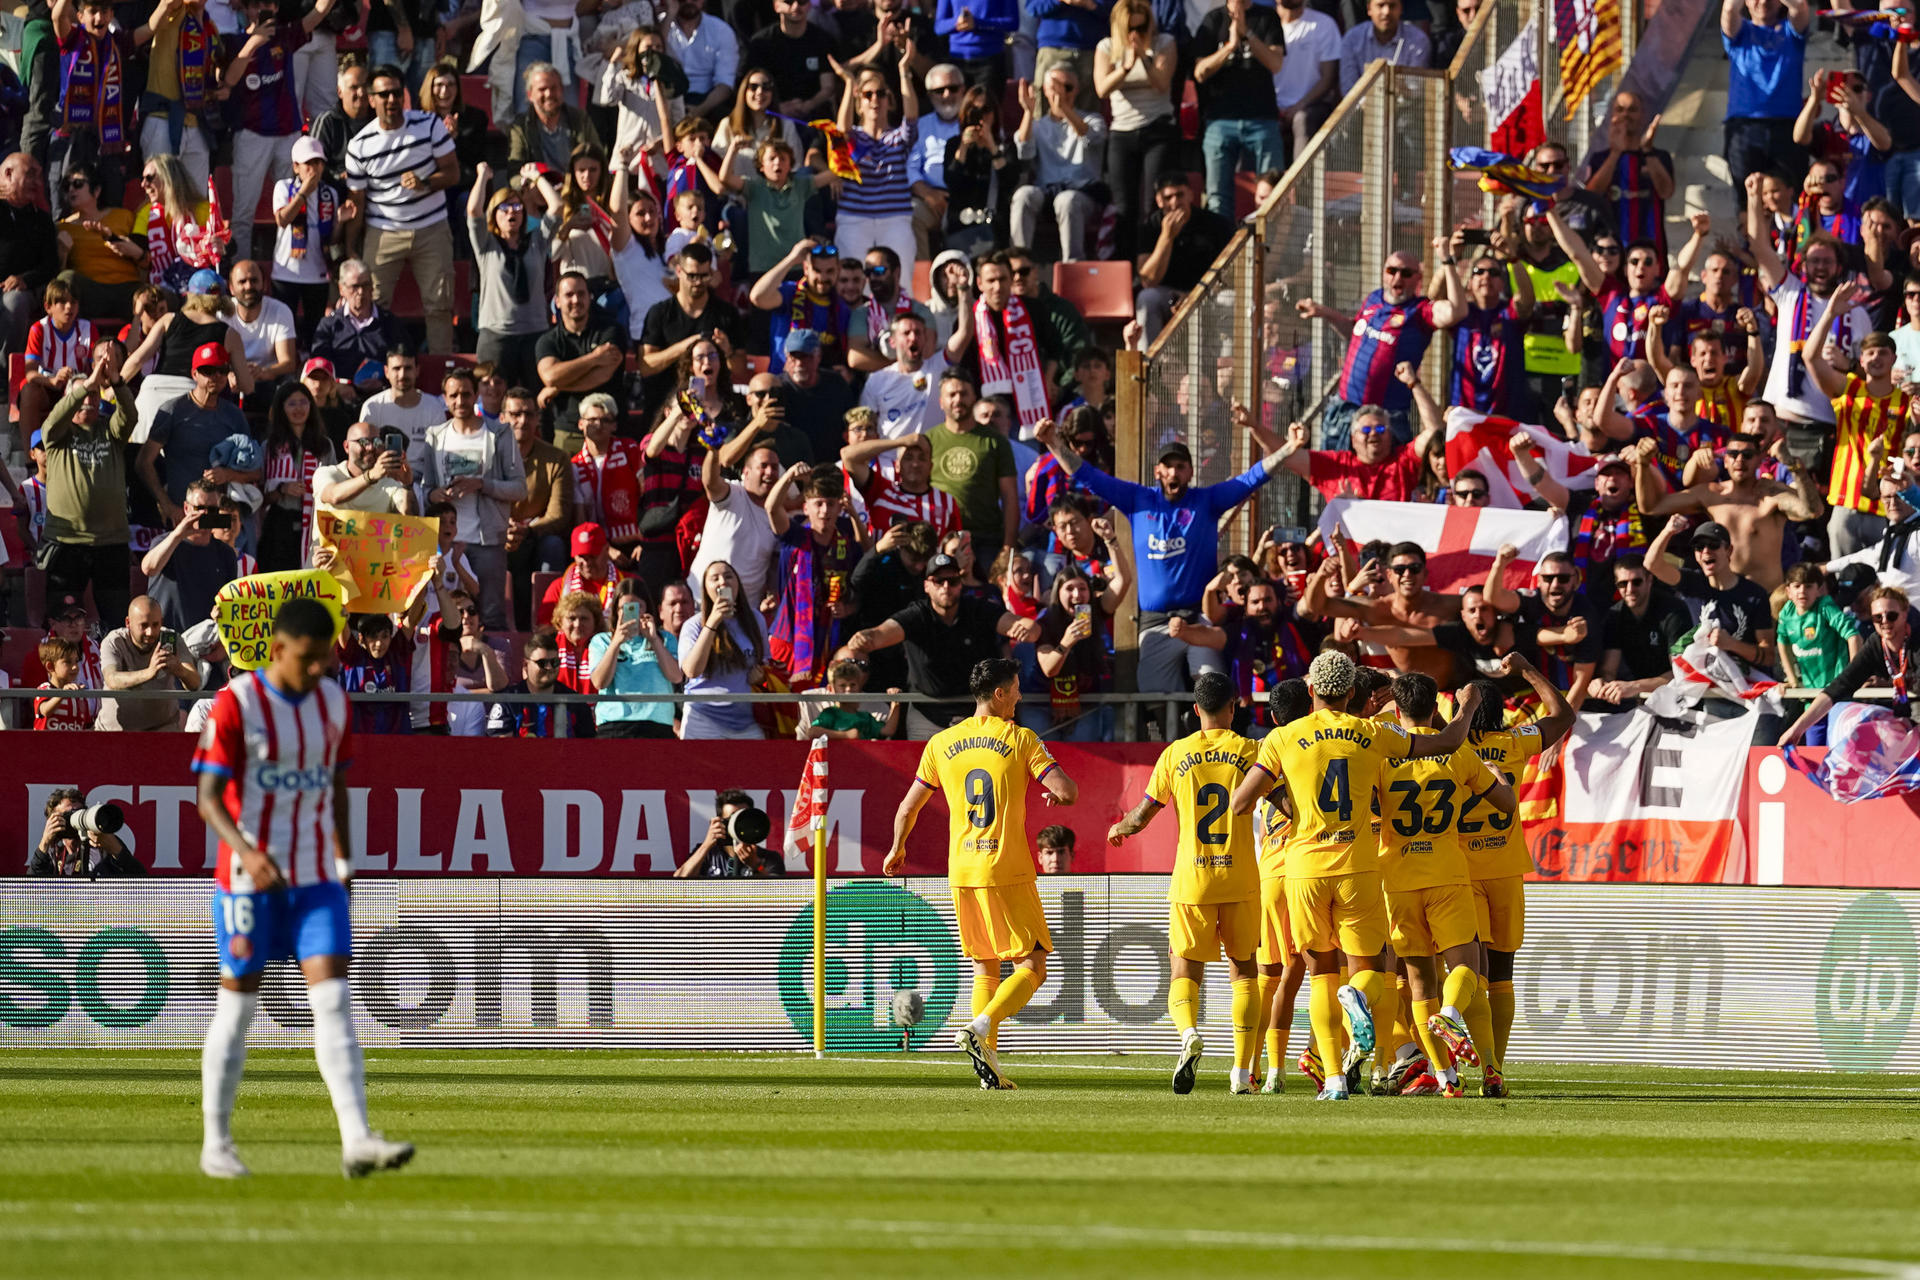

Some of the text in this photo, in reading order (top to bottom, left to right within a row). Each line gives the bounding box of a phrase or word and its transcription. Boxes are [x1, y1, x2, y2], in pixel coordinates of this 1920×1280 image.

[320, 516, 358, 537] TER
[1147, 533, 1186, 553] beko
[228, 640, 268, 663] POR
[943, 735, 1014, 762] LEWANDOWSKI
[1314, 728, 1373, 751] ARAUJO
[1175, 750, 1252, 778] JOÃO CANCEL
[964, 768, 996, 829] 9
[1317, 758, 1353, 822] 4
[1196, 782, 1230, 845] 2
[1388, 778, 1457, 837] 33
[220, 895, 255, 935] 16
[1523, 932, 1726, 1038] com
